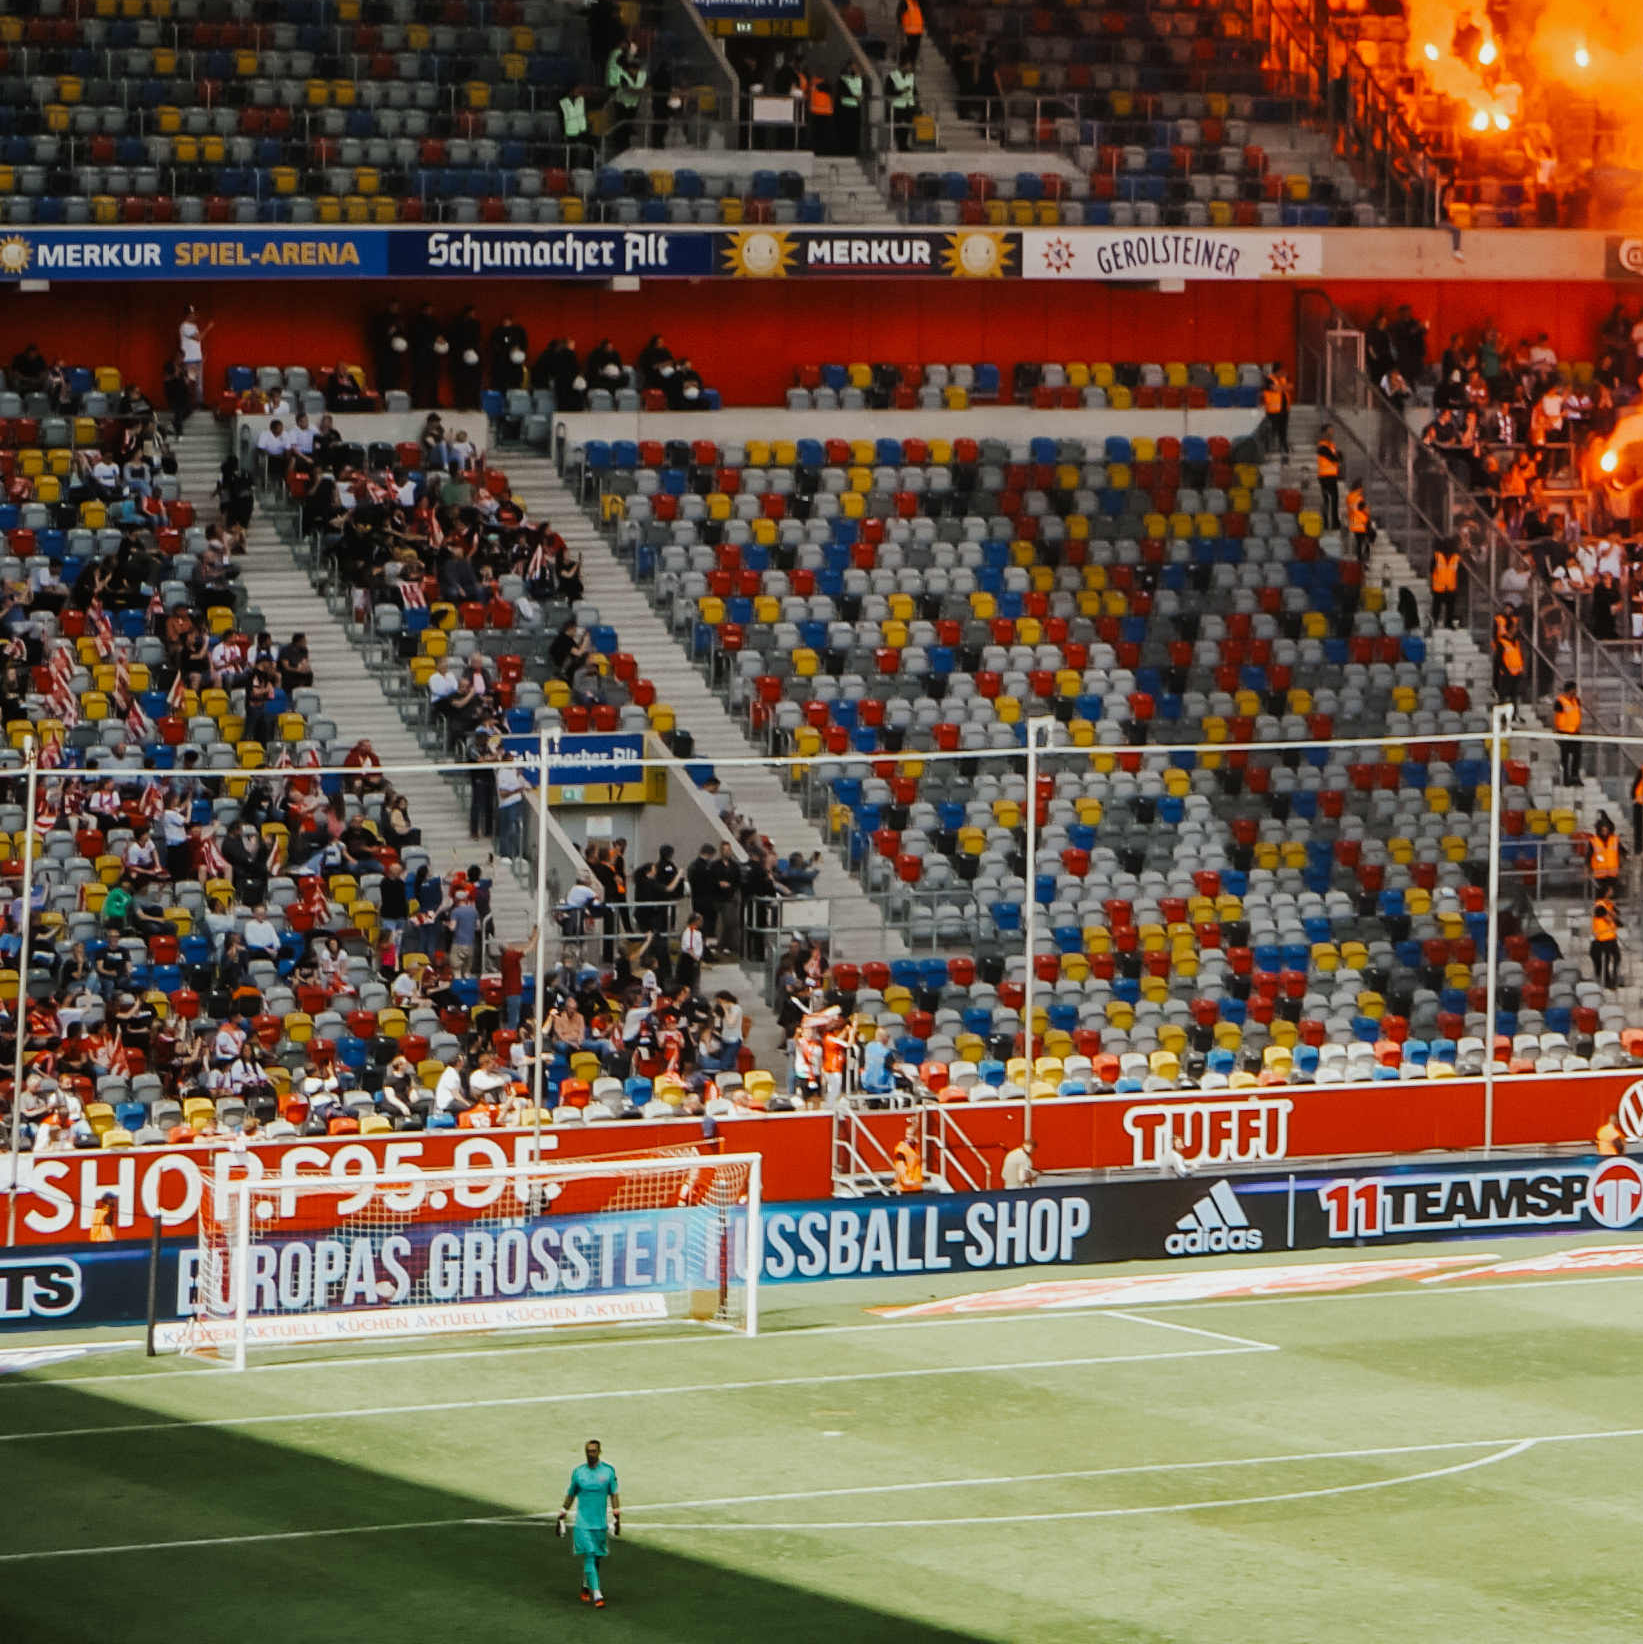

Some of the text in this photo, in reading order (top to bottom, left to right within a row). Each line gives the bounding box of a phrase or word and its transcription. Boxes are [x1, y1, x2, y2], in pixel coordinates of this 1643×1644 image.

[37, 242, 360, 267] MERKUR SPIEL-ARENA
[428, 232, 669, 271] Schumacher Alt
[807, 240, 931, 265] MERKUR
[1097, 235, 1241, 276] GEROLSTEINER
[608, 783, 625, 802] 17
[1165, 1224, 1263, 1256] adidas
[428, 1217, 688, 1299] GRÖSSTER
[244, 1321, 323, 1341] AKTUELL
[337, 1314, 409, 1334] KÜCHEN
[414, 1310, 492, 1329] AKTUELL
[505, 1305, 577, 1324] KÜCHEN
[584, 1300, 660, 1319] AKTUELL
